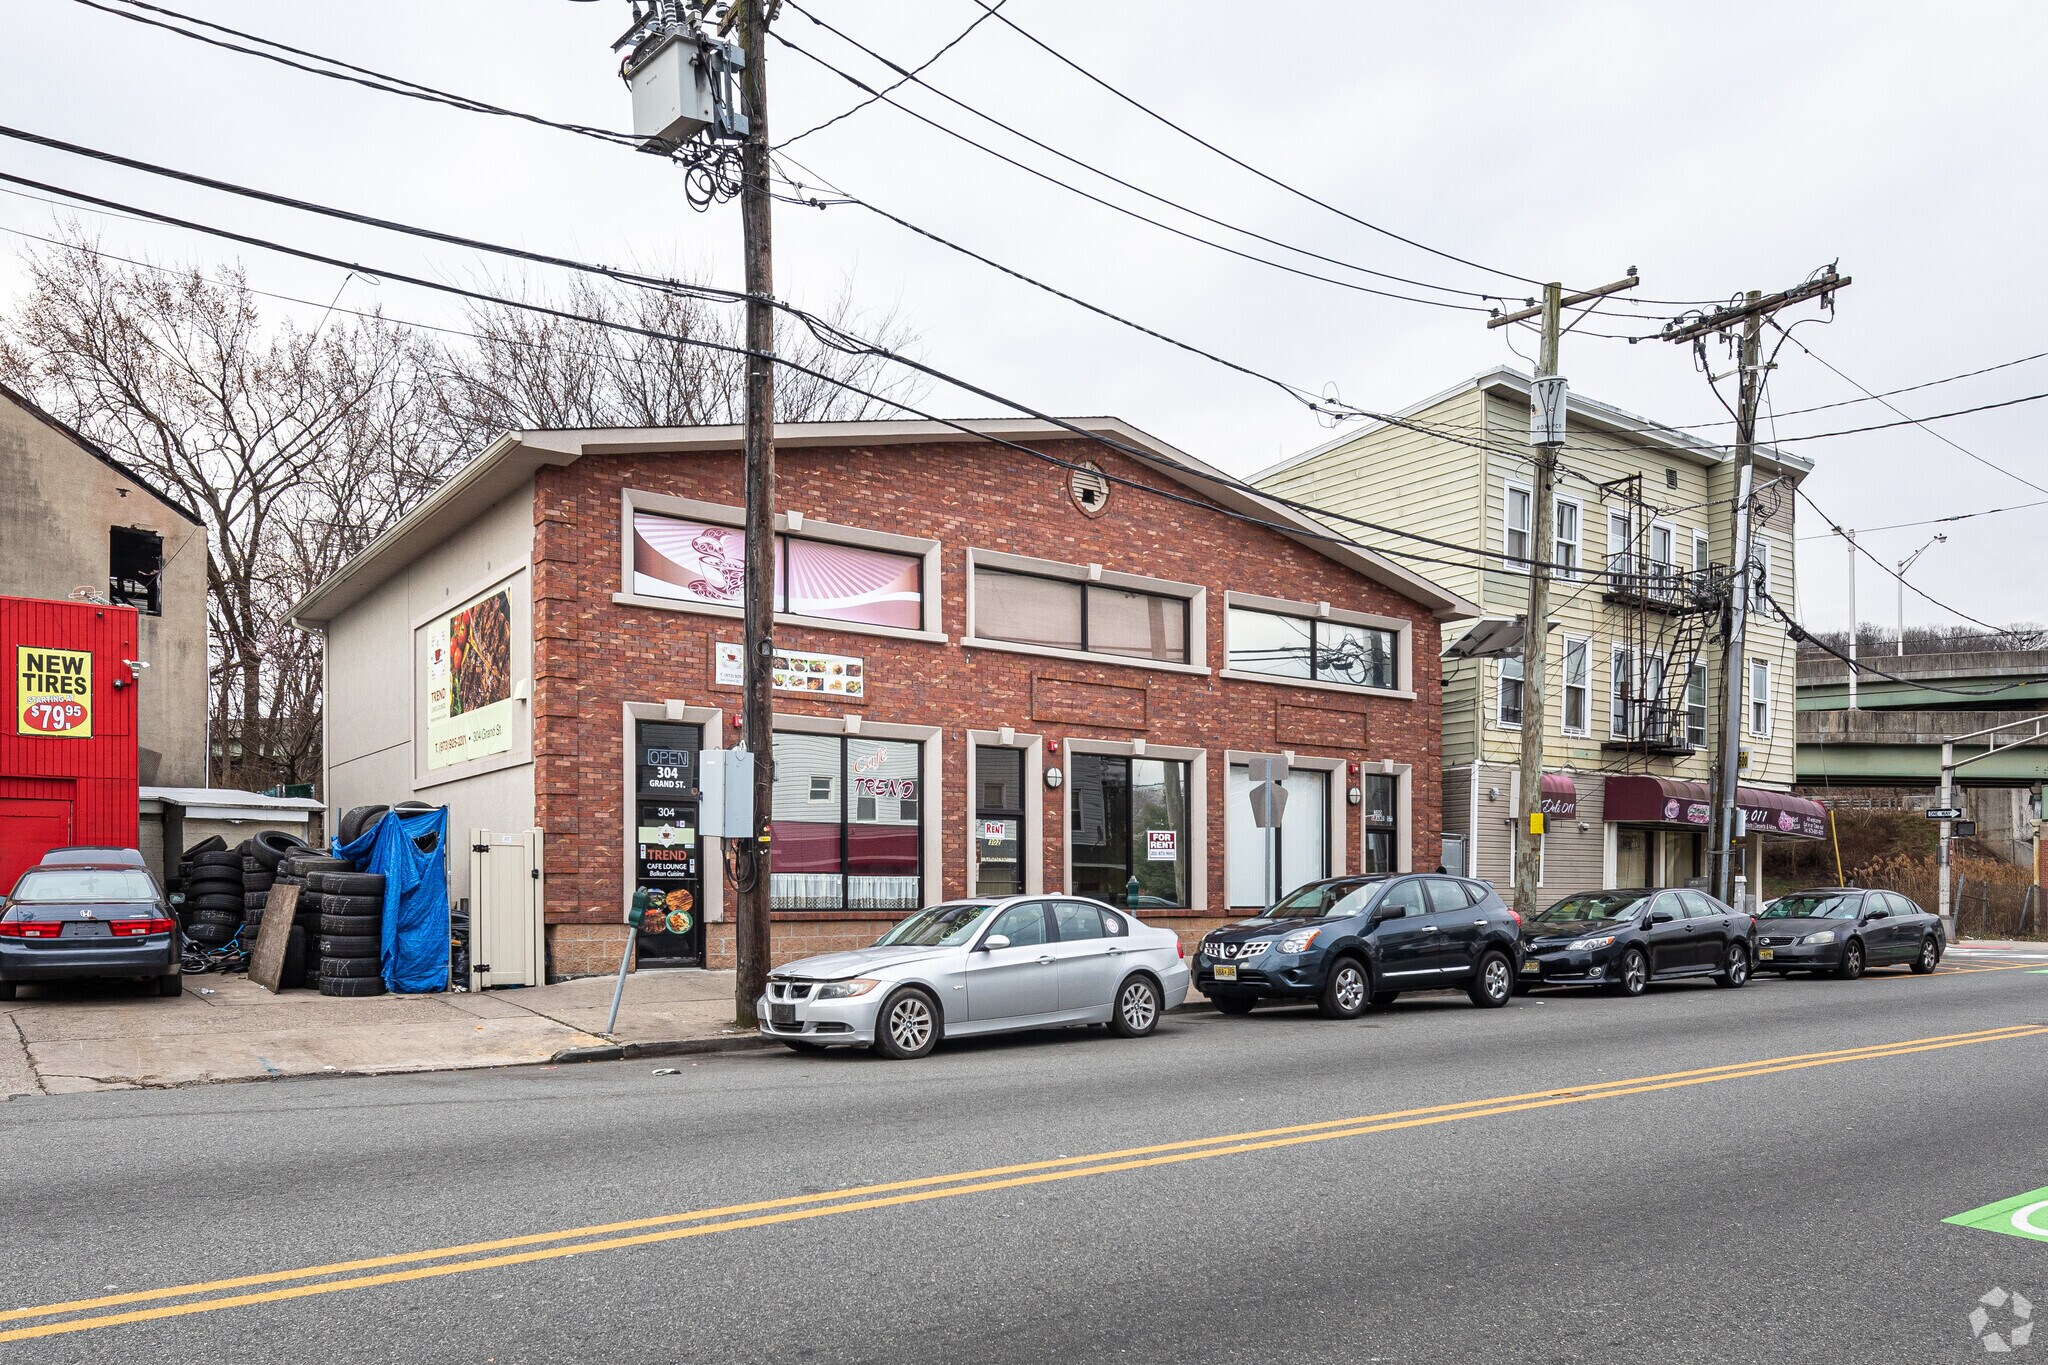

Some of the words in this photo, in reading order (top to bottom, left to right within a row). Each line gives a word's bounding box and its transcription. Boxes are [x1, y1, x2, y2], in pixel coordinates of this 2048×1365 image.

[27, 653, 84, 676] NEW
[22, 673, 87, 695] TIRES
[27, 695, 64, 704] STARTING
[65, 694, 75, 703] AT
[431, 688, 446, 703] TREND
[481, 726, 496, 740] Grand
[650, 751, 687, 765] OPEN
[657, 767, 679, 779] 304
[649, 779, 675, 788] GRAND
[675, 781, 686, 789] ST.
[854, 777, 914, 798] TREND
[1541, 798, 1561, 813] Deli
[1562, 802, 1575, 813] 011
[658, 808, 675, 817] 304
[1750, 809, 1768, 822] 011
[986, 823, 1004, 834] RENT
[1150, 841, 1174, 849] RENT
[647, 849, 687, 860] TREND
